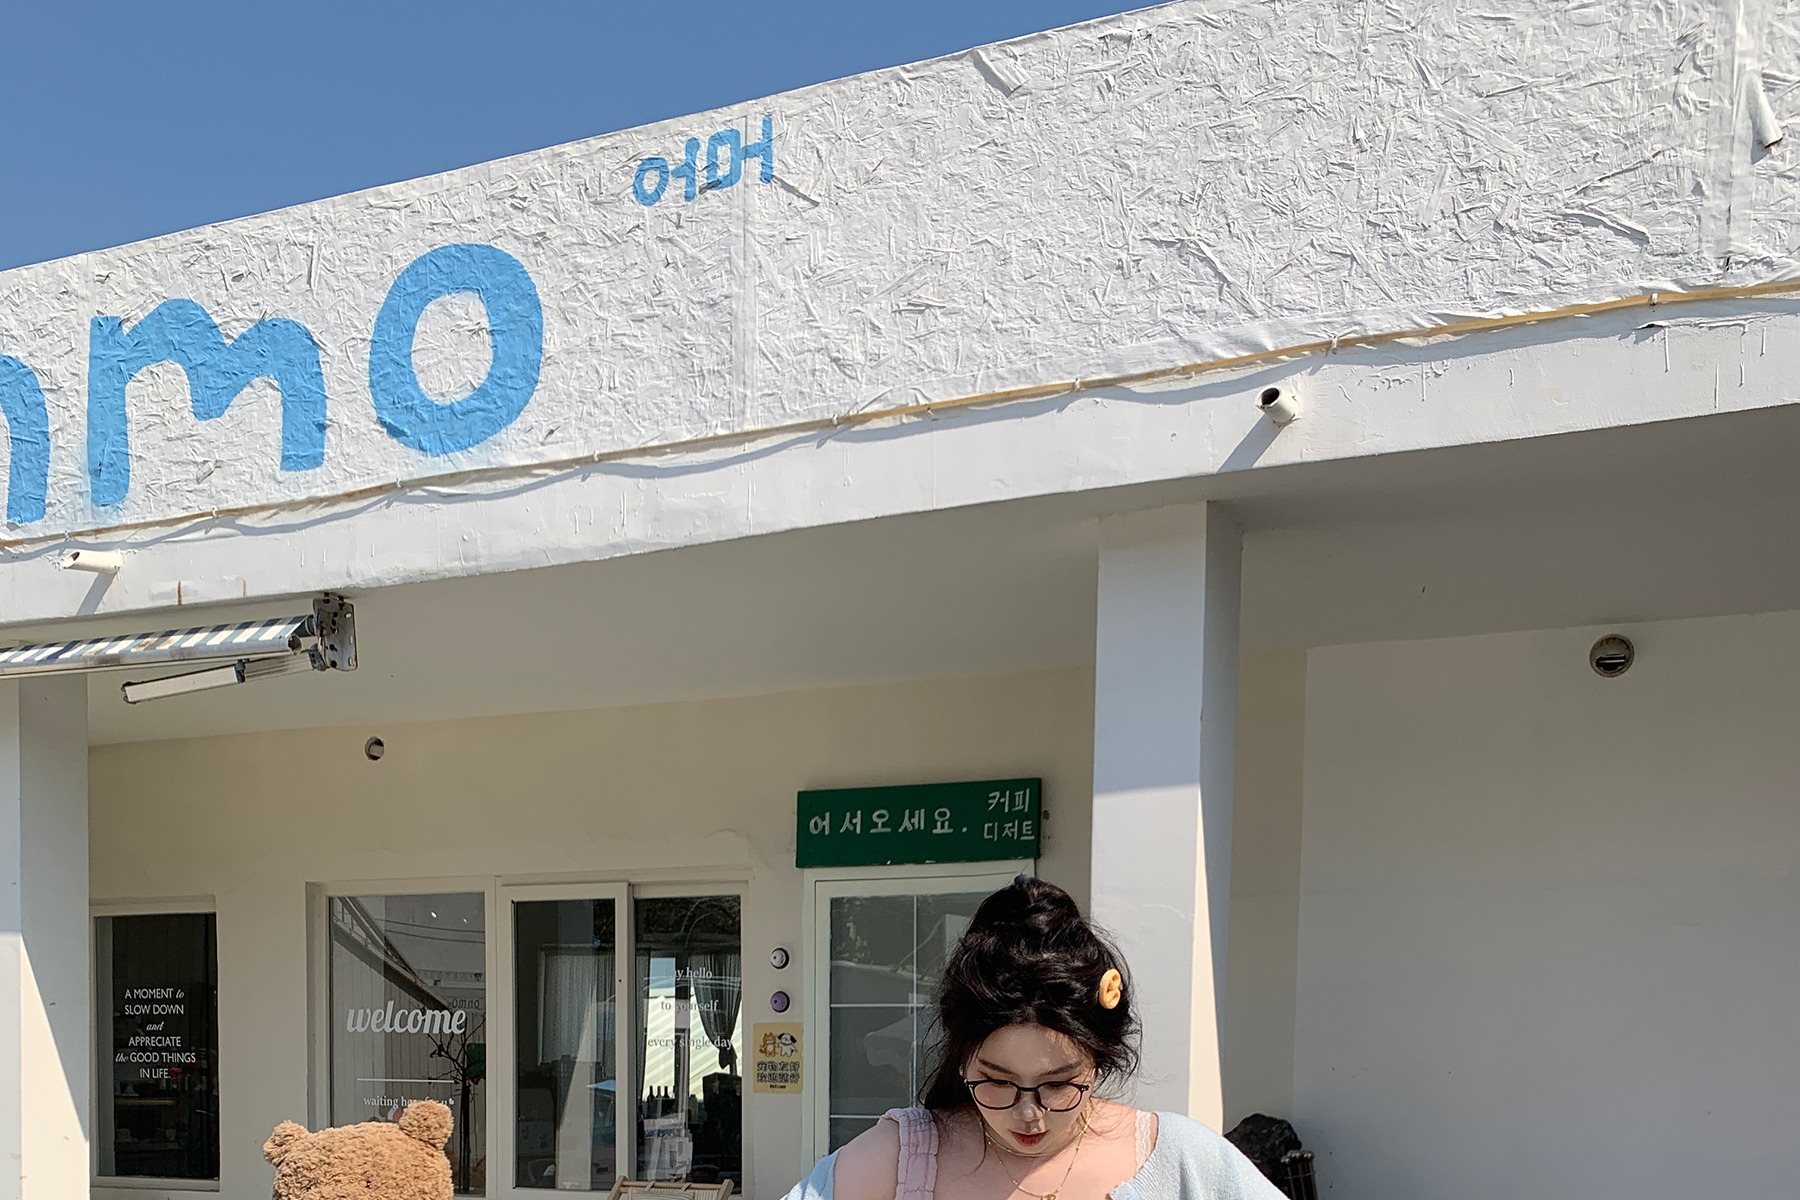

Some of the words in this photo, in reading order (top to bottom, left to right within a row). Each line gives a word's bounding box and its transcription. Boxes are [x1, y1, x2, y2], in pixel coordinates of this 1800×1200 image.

[633, 114, 773, 206] 어머
[988, 788, 1030, 813] 커피
[983, 820, 1035, 842] 디저트
[686, 967, 713, 979] hello
[124, 988, 132, 999] A
[133, 988, 174, 999] MOMENT
[124, 1004, 151, 1015] SLOW
[152, 1004, 184, 1015] DOWN
[661, 1000, 672, 1011] to
[676, 1000, 719, 1014] yourself
[346, 1000, 467, 1034] welcome
[146, 1021, 165, 1031] and
[128, 1036, 182, 1047] APPRECIATE
[647, 1037, 676, 1049] every
[679, 1035, 711, 1050] single
[714, 1036, 733, 1050] day
[115, 1053, 129, 1063] the
[129, 1052, 160, 1063] GOOD
[161, 1052, 196, 1063] THINGS
[139, 1068, 150, 1079] IN
[152, 1068, 171, 1079] LIFE.
[363, 1095, 399, 1109] waiting
